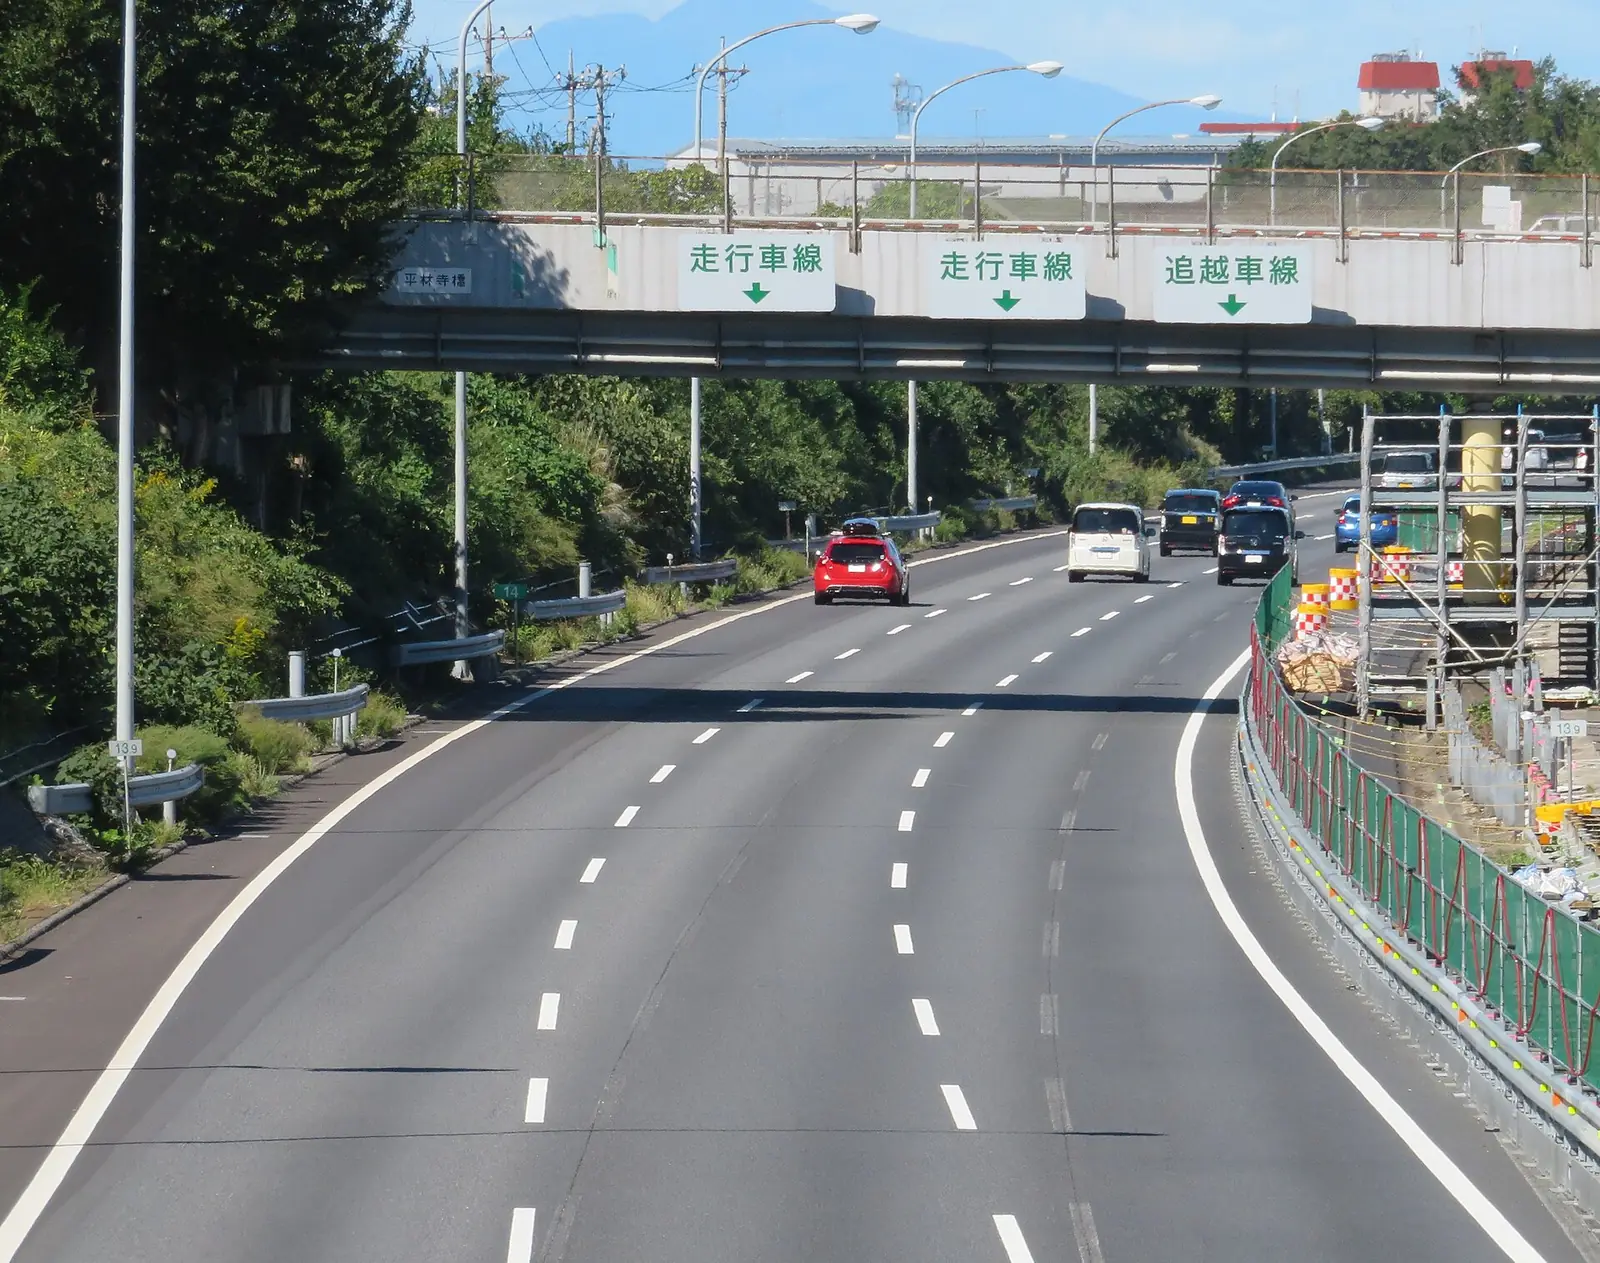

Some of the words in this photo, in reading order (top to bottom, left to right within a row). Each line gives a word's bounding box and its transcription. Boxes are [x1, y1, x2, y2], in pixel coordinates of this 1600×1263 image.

[690, 243, 823, 273] 走行車線
[940, 251, 1073, 282] 走行車線
[1165, 255, 1299, 285] 追越車線
[503, 586, 518, 598] 14
